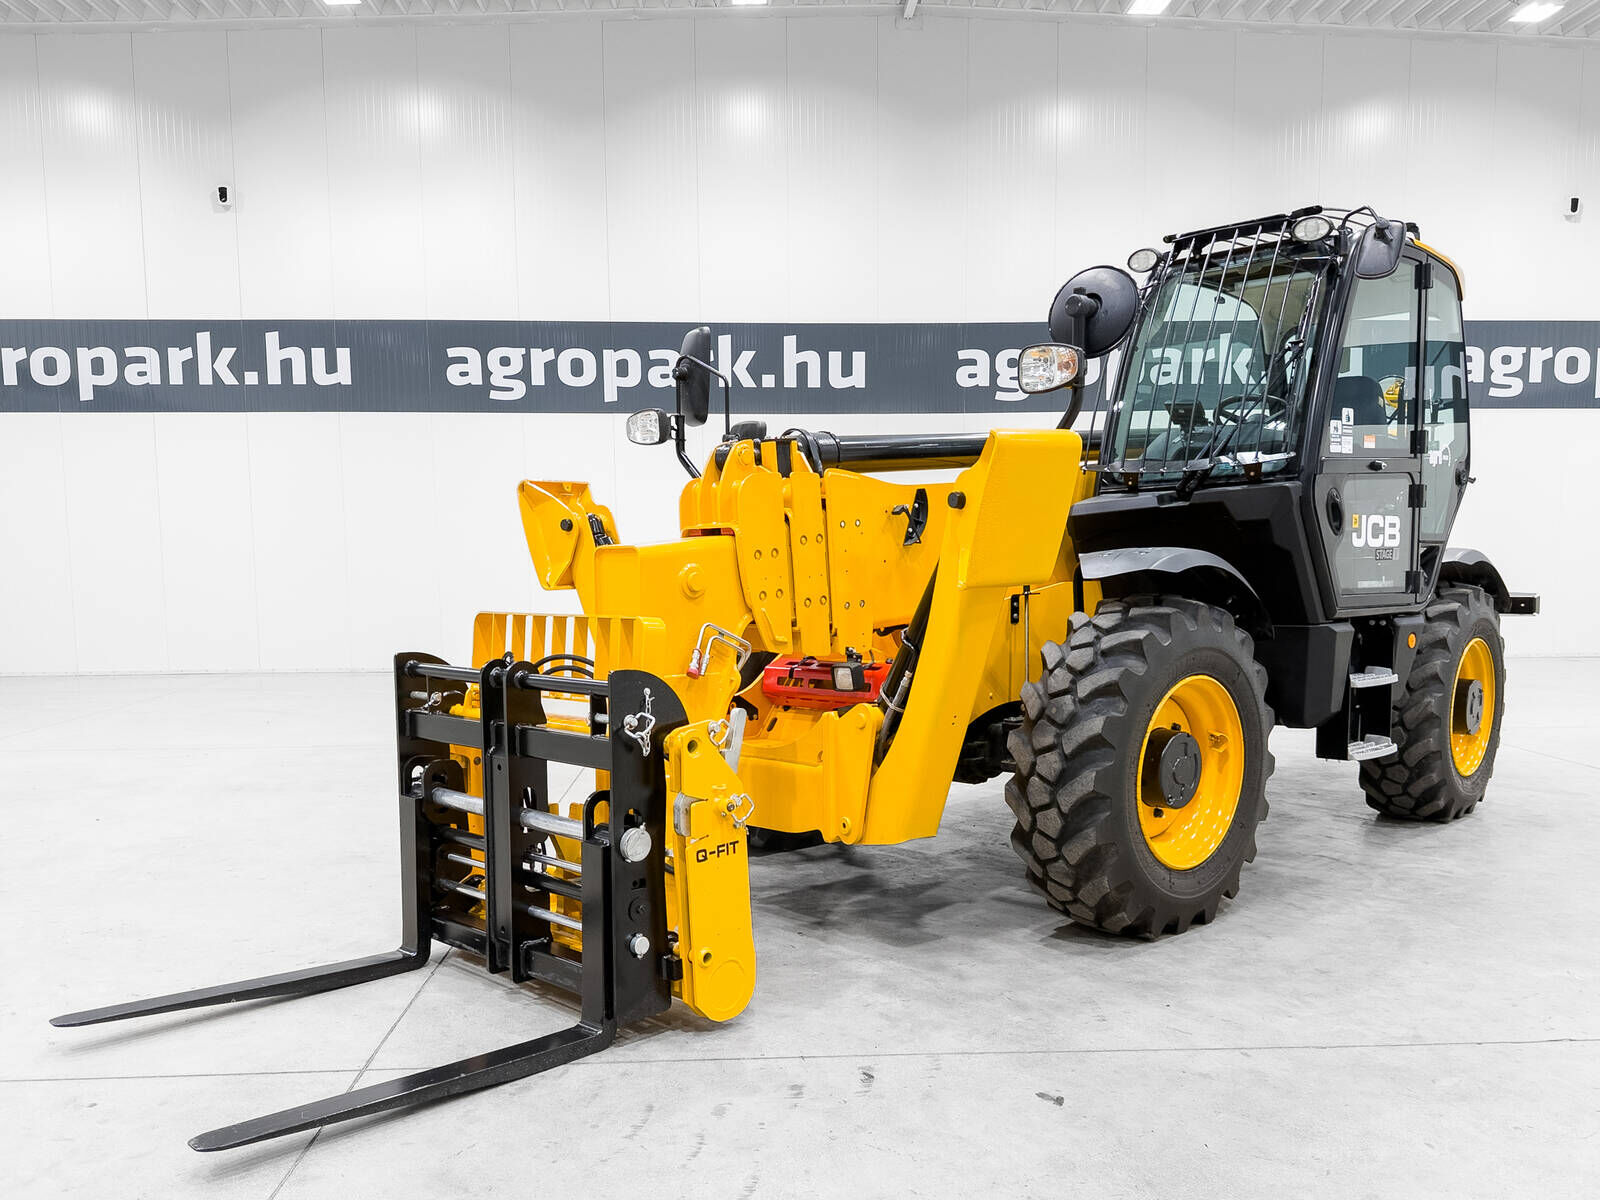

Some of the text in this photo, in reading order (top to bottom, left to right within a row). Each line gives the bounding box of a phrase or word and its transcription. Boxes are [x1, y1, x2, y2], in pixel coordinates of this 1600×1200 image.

[446, 334, 867, 403] agropak.hu
[1466, 345, 1600, 399] agro
[1351, 514, 1400, 548] JCB
[696, 840, 739, 863] Q-FIT
